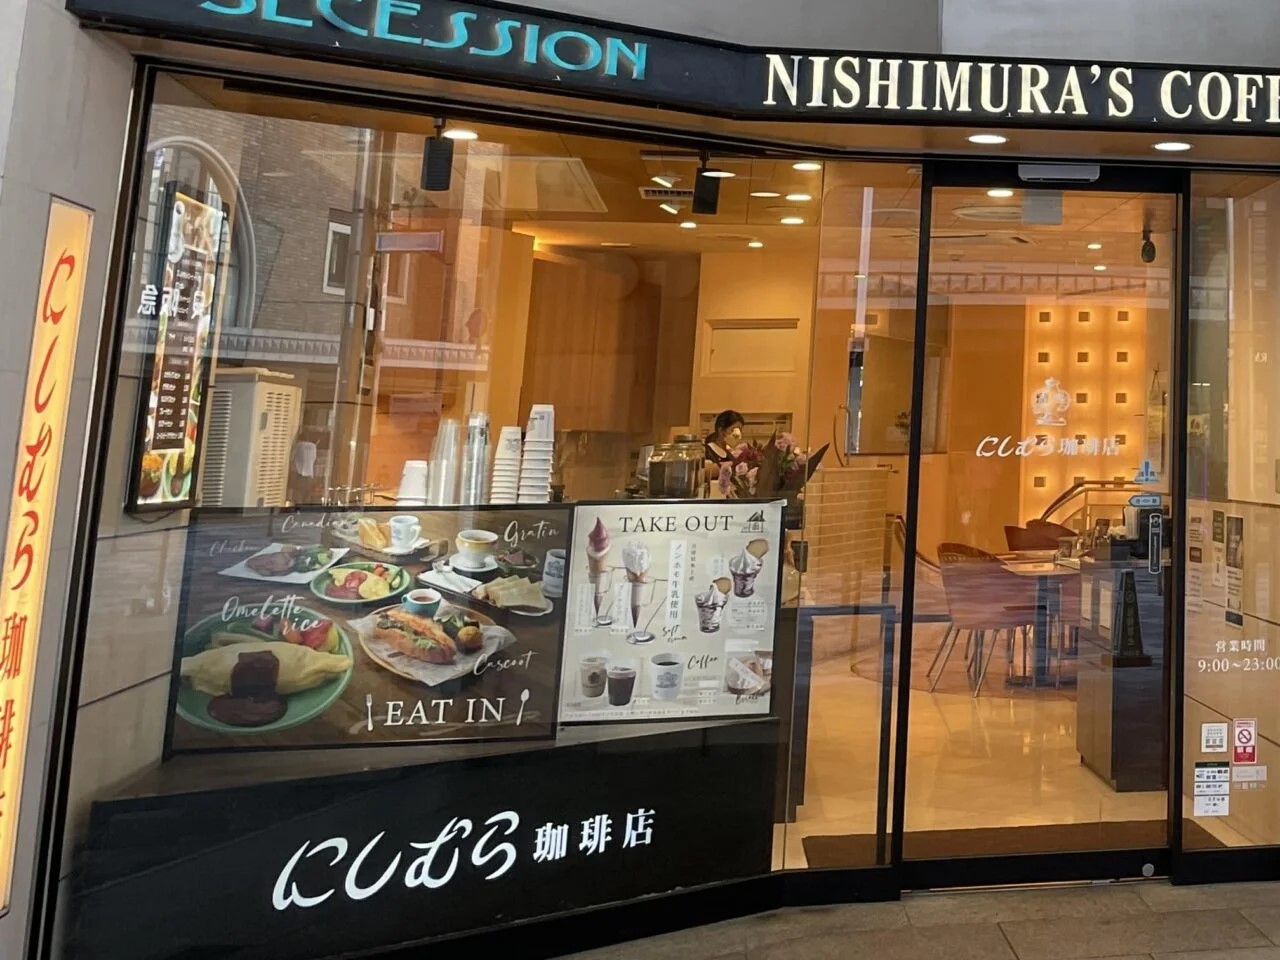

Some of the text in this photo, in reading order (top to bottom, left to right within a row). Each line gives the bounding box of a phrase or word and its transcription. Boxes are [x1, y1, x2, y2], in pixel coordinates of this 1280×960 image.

[763, 53, 1134, 119] NISHIMURA'S
[504, 520, 560, 548] Gratin
[619, 514, 733, 533] TAKE OUT
[221, 594, 305, 624] Omelette
[281, 615, 323, 636] rice
[1215, 639, 1266, 653] 営業時間
[473, 650, 539, 677] Cascoot
[384, 697, 507, 727] EAT IN
